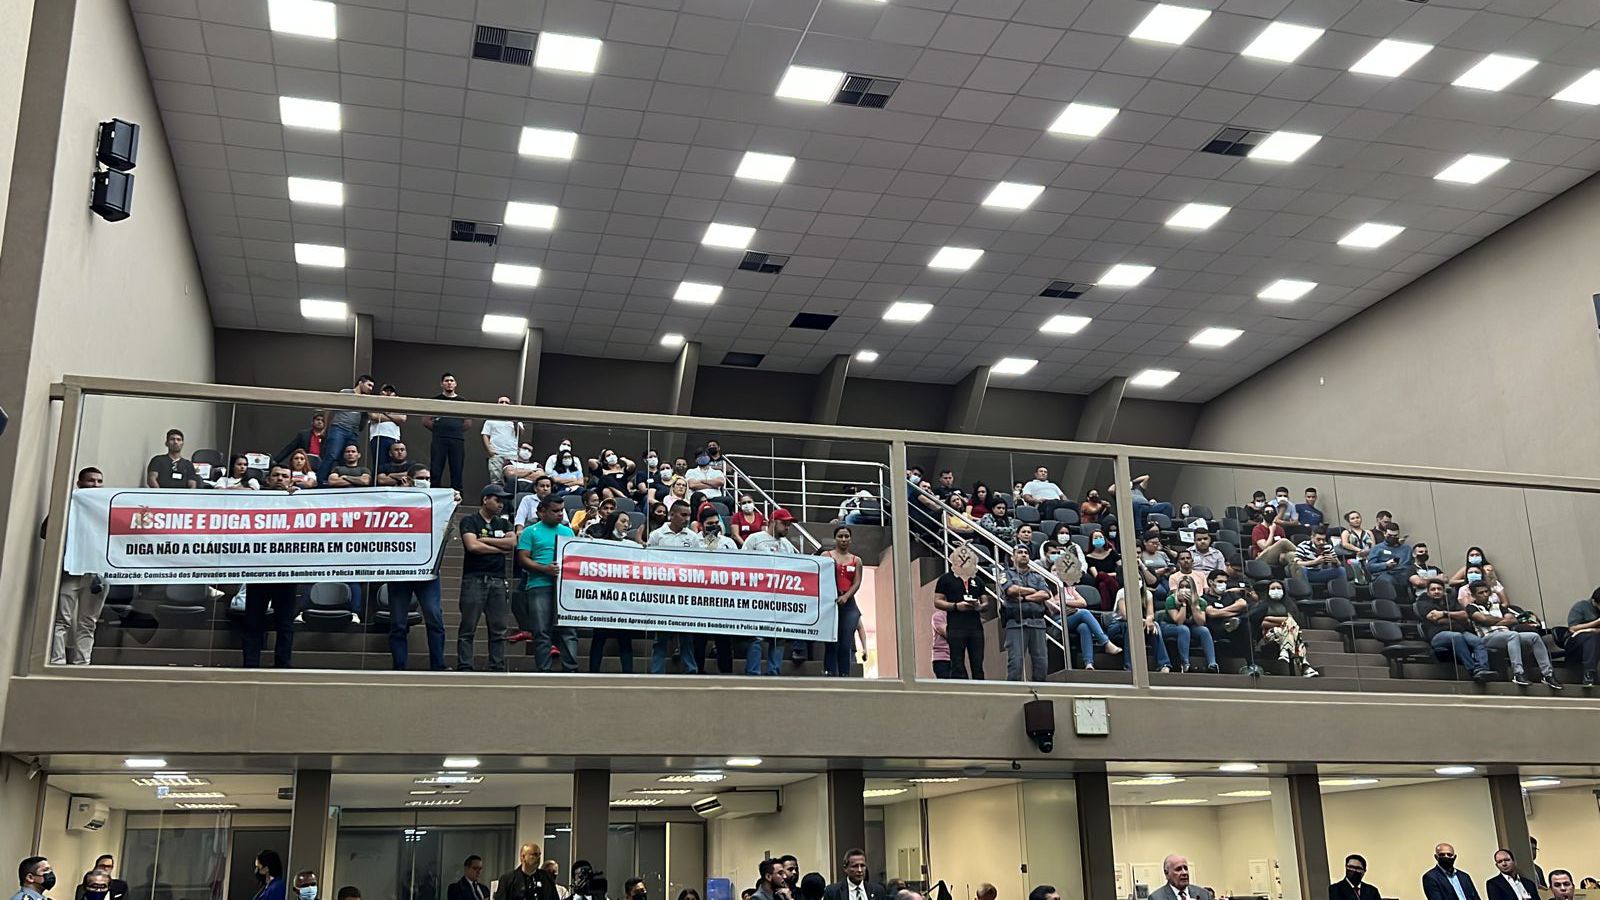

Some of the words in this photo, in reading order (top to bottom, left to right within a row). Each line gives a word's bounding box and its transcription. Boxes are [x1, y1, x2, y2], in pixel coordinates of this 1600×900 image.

[130, 512, 194, 529] ASSINE
[196, 513, 206, 529] E
[209, 513, 251, 530] DIGA
[254, 513, 291, 531] SIM,
[293, 512, 317, 529] AO
[320, 512, 339, 528] PL
[342, 511, 361, 528] Nº
[363, 511, 414, 528] 77/22.
[126, 543, 154, 555] DIGA
[156, 541, 180, 554] NÃO
[182, 543, 190, 554] A
[192, 541, 251, 554] CLÁUSULA
[253, 542, 267, 554] DE
[270, 542, 325, 554] BARREIRA
[327, 541, 343, 553] EM
[345, 541, 416, 553] CONCURSOS!
[144, 571, 178, 579] Comissão
[179, 571, 191, 579] dos
[192, 571, 227, 580] Aprovados
[241, 570, 276, 578] Concursos
[386, 568, 417, 576] Amazonas
[578, 561, 630, 579] ASSINE
[632, 565, 641, 580] E
[642, 565, 677, 582] DIGA
[679, 567, 708, 585] SIM,
[710, 570, 729, 585] AO
[731, 571, 747, 587] PL
[749, 572, 765, 588] Nº
[766, 573, 805, 591] 77/22.
[575, 588, 599, 600] DIGA
[600, 589, 619, 602] NÃO
[620, 591, 628, 602] A
[629, 590, 676, 605] CLÁUSULA
[678, 595, 689, 606] DE
[691, 595, 736, 608] BARREIRA
[737, 598, 750, 609] EM
[751, 599, 807, 613] CONCURSOS!
[589, 615, 617, 623] Comissão
[628, 617, 657, 626] Aprovados
[668, 619, 696, 627] Concursos
[707, 622, 736, 630] Bombeiros
[759, 624, 776, 632] Militar
[783, 626, 807, 635] Amazonas
